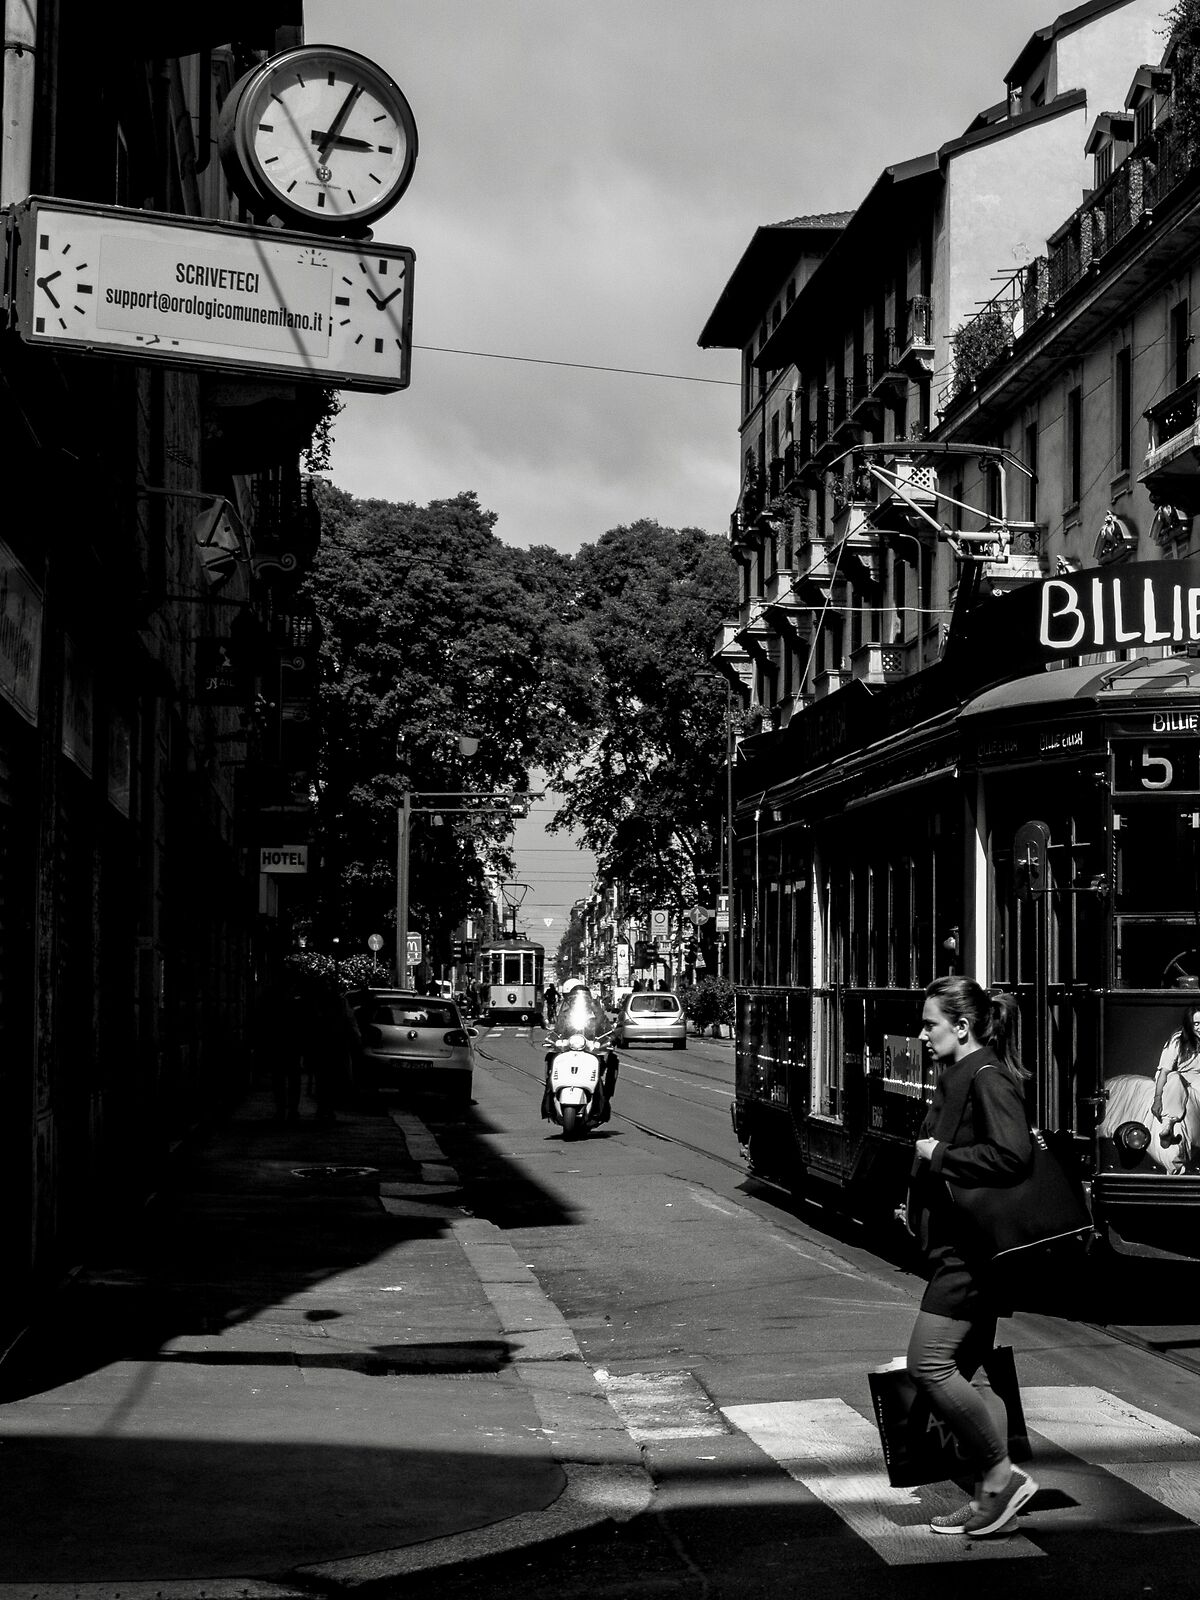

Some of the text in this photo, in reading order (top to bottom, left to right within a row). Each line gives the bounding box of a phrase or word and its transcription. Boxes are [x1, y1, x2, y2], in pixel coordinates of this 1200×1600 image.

[176, 262, 260, 294] SCRIVETECI
[105, 287, 323, 332] support@orologicomunemilano.it
[1152, 713, 1198, 732] BILLIE
[1141, 745, 1173, 789] 5
[262, 851, 305, 866] HOTEL
